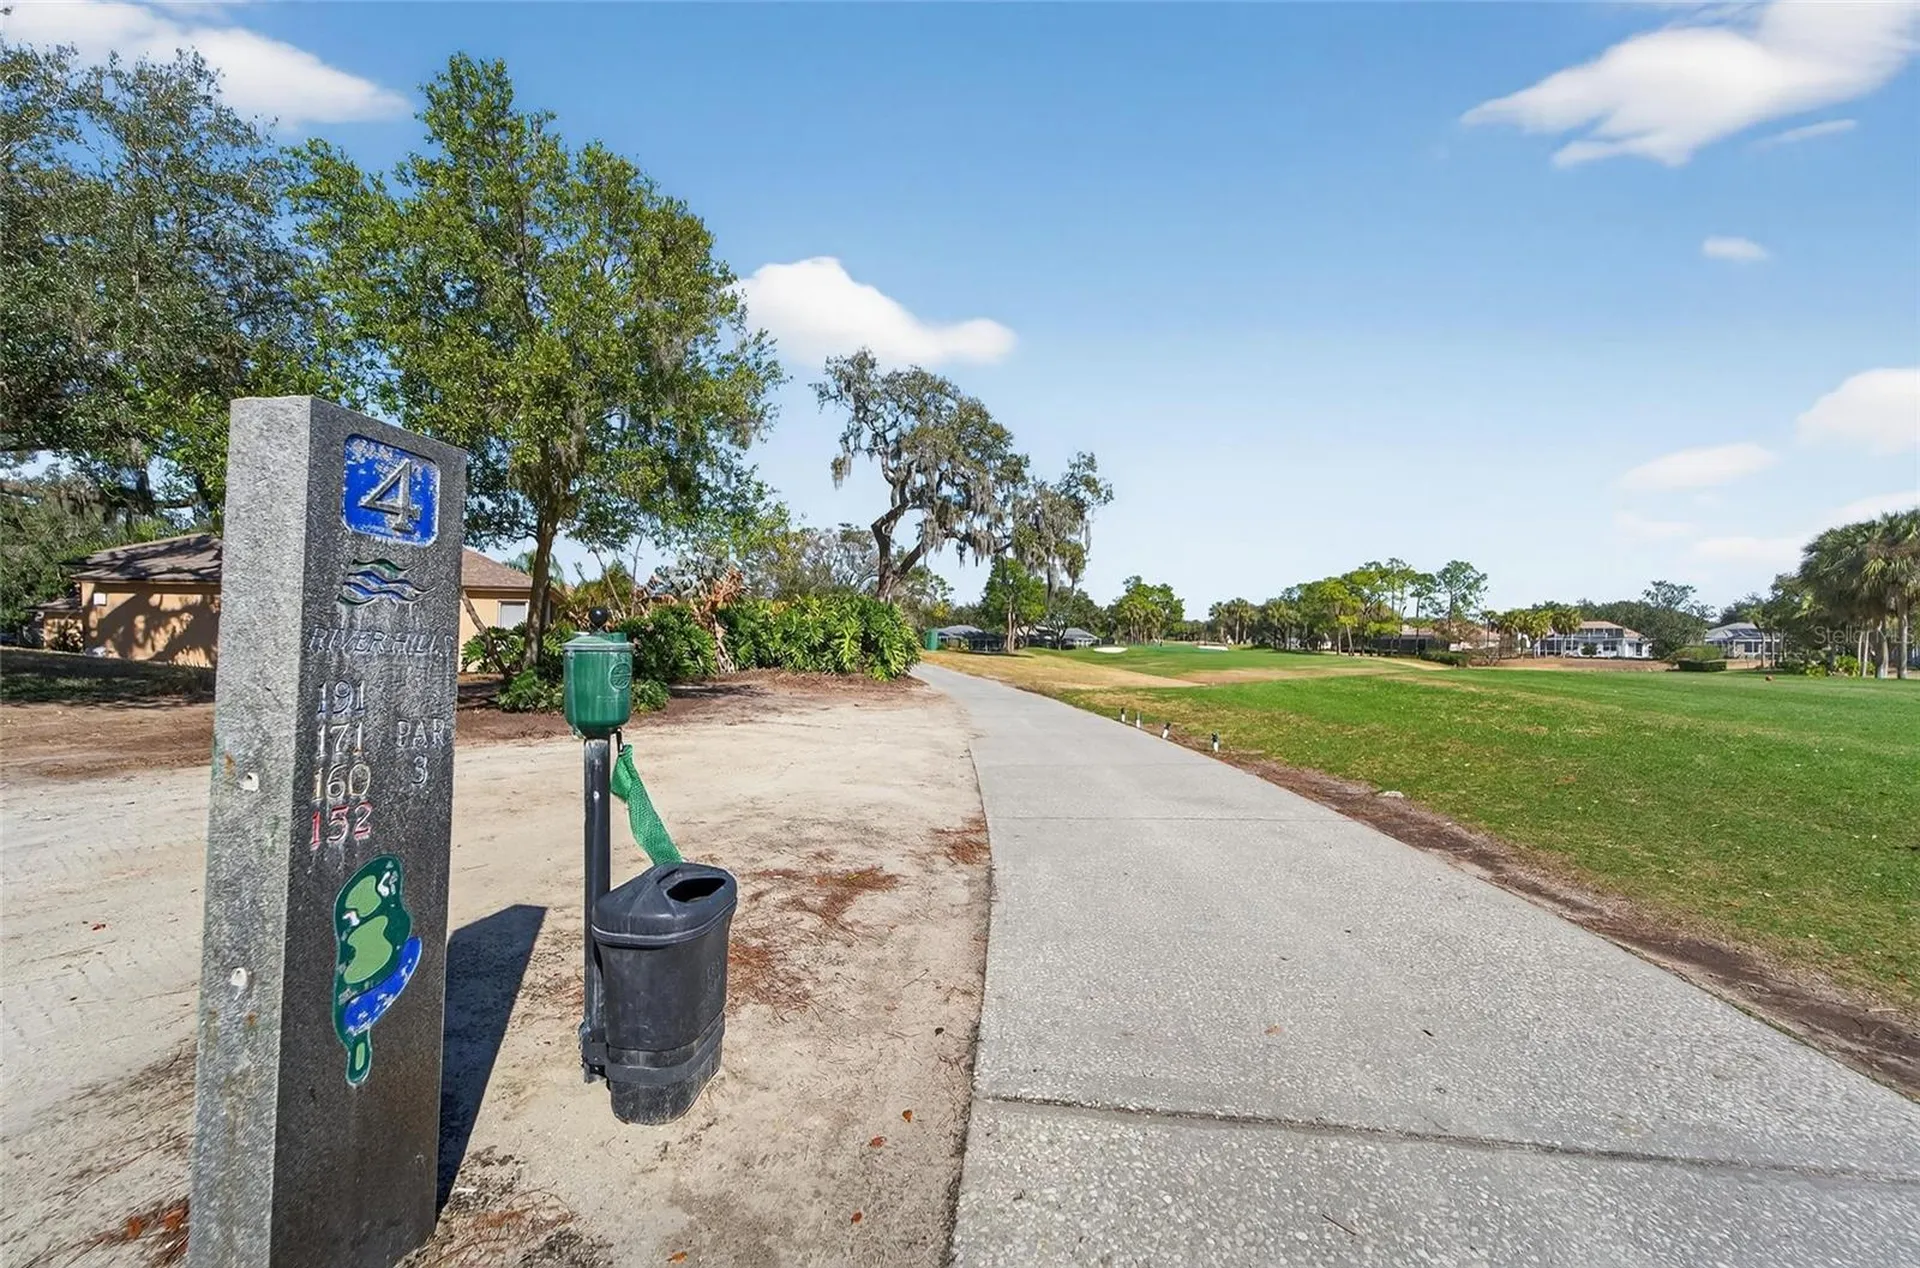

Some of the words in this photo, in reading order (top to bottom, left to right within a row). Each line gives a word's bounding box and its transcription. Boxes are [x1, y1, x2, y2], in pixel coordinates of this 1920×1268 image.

[358, 458, 421, 533] 4
[308, 626, 388, 655] RIVER
[316, 680, 366, 717] 191
[316, 722, 364, 759] 171
[396, 718, 446, 749] PAR
[312, 762, 372, 804] 160
[411, 755, 429, 787] 3
[310, 801, 373, 851] 152
